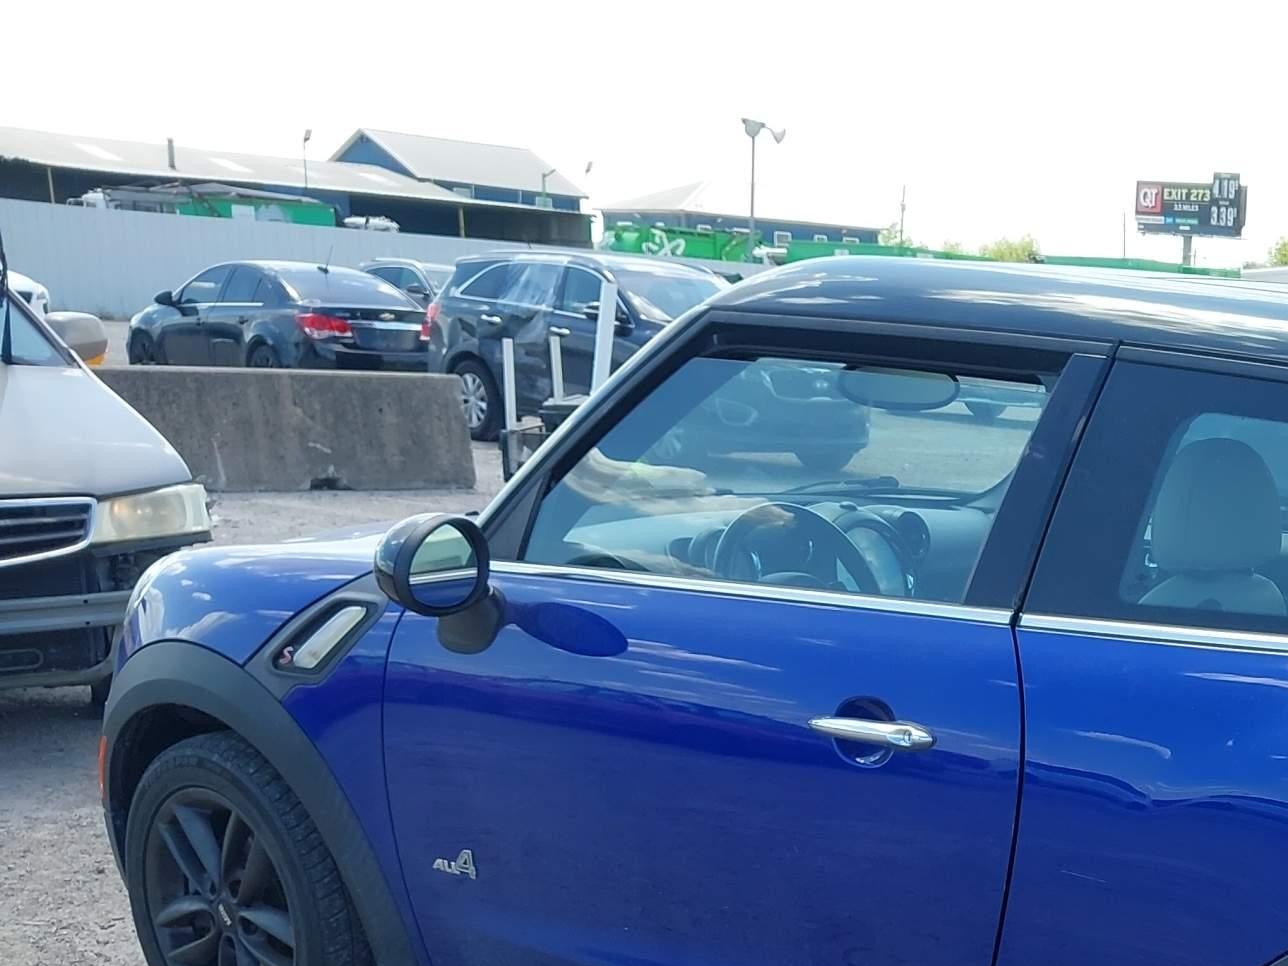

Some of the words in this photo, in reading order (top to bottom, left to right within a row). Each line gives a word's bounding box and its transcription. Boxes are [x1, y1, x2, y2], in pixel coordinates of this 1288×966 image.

[1140, 187, 1157, 208] QT
[1163, 188, 1187, 201] EXIT
[1190, 189, 1210, 202] 273
